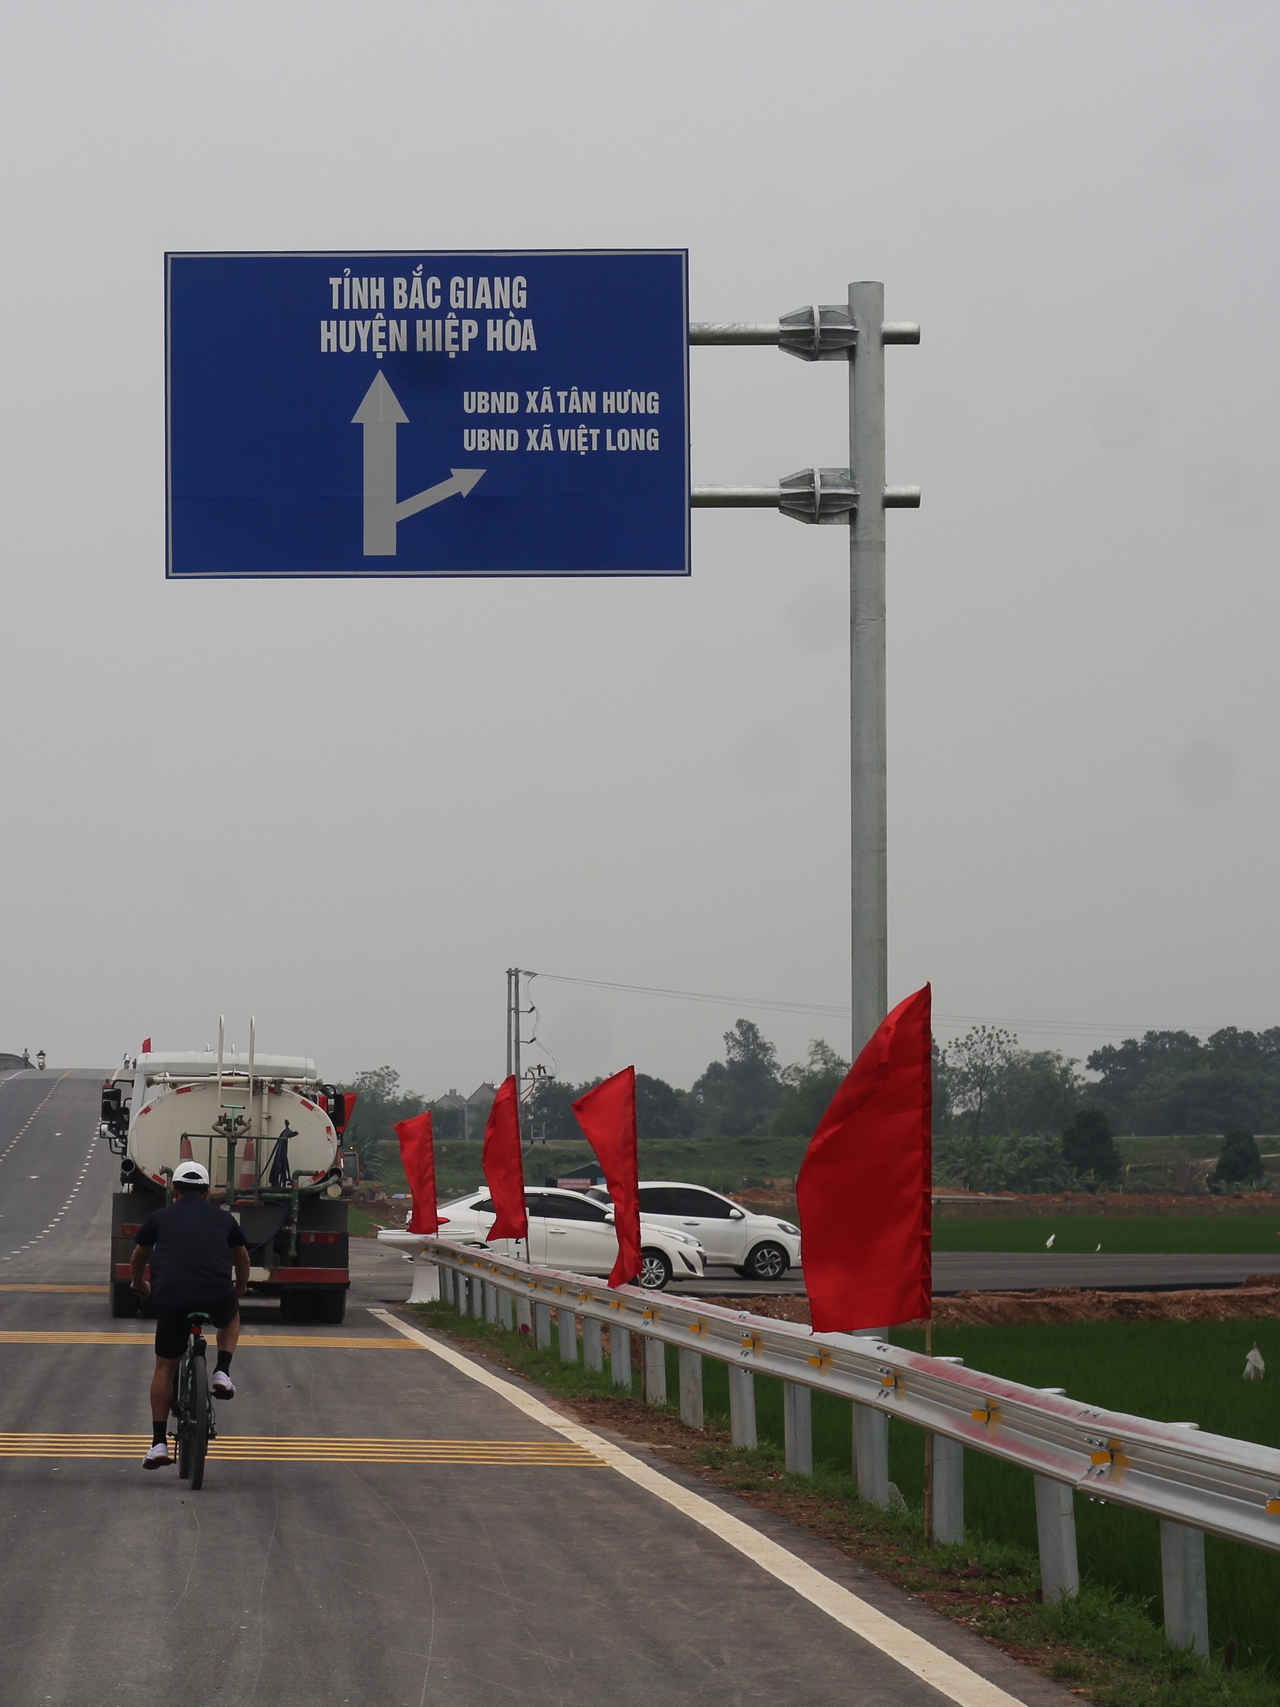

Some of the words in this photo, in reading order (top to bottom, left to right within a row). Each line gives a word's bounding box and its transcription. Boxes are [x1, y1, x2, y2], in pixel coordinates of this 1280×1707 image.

[328, 267, 385, 310] TỈNH
[392, 263, 442, 310] BẮC
[449, 275, 528, 310] GIANG
[320, 312, 408, 359] HUYỆN
[416, 312, 479, 359] HIỆP
[486, 310, 538, 352] HÒA
[463, 391, 519, 414] UBND
[525, 386, 553, 414] XÃ
[557, 386, 597, 414] TÂN
[602, 388, 660, 414] HƯNG
[463, 428, 519, 452] UBND
[525, 423, 553, 452] XÃ
[557, 423, 601, 456] VIỆT
[607, 428, 660, 452] LONG
